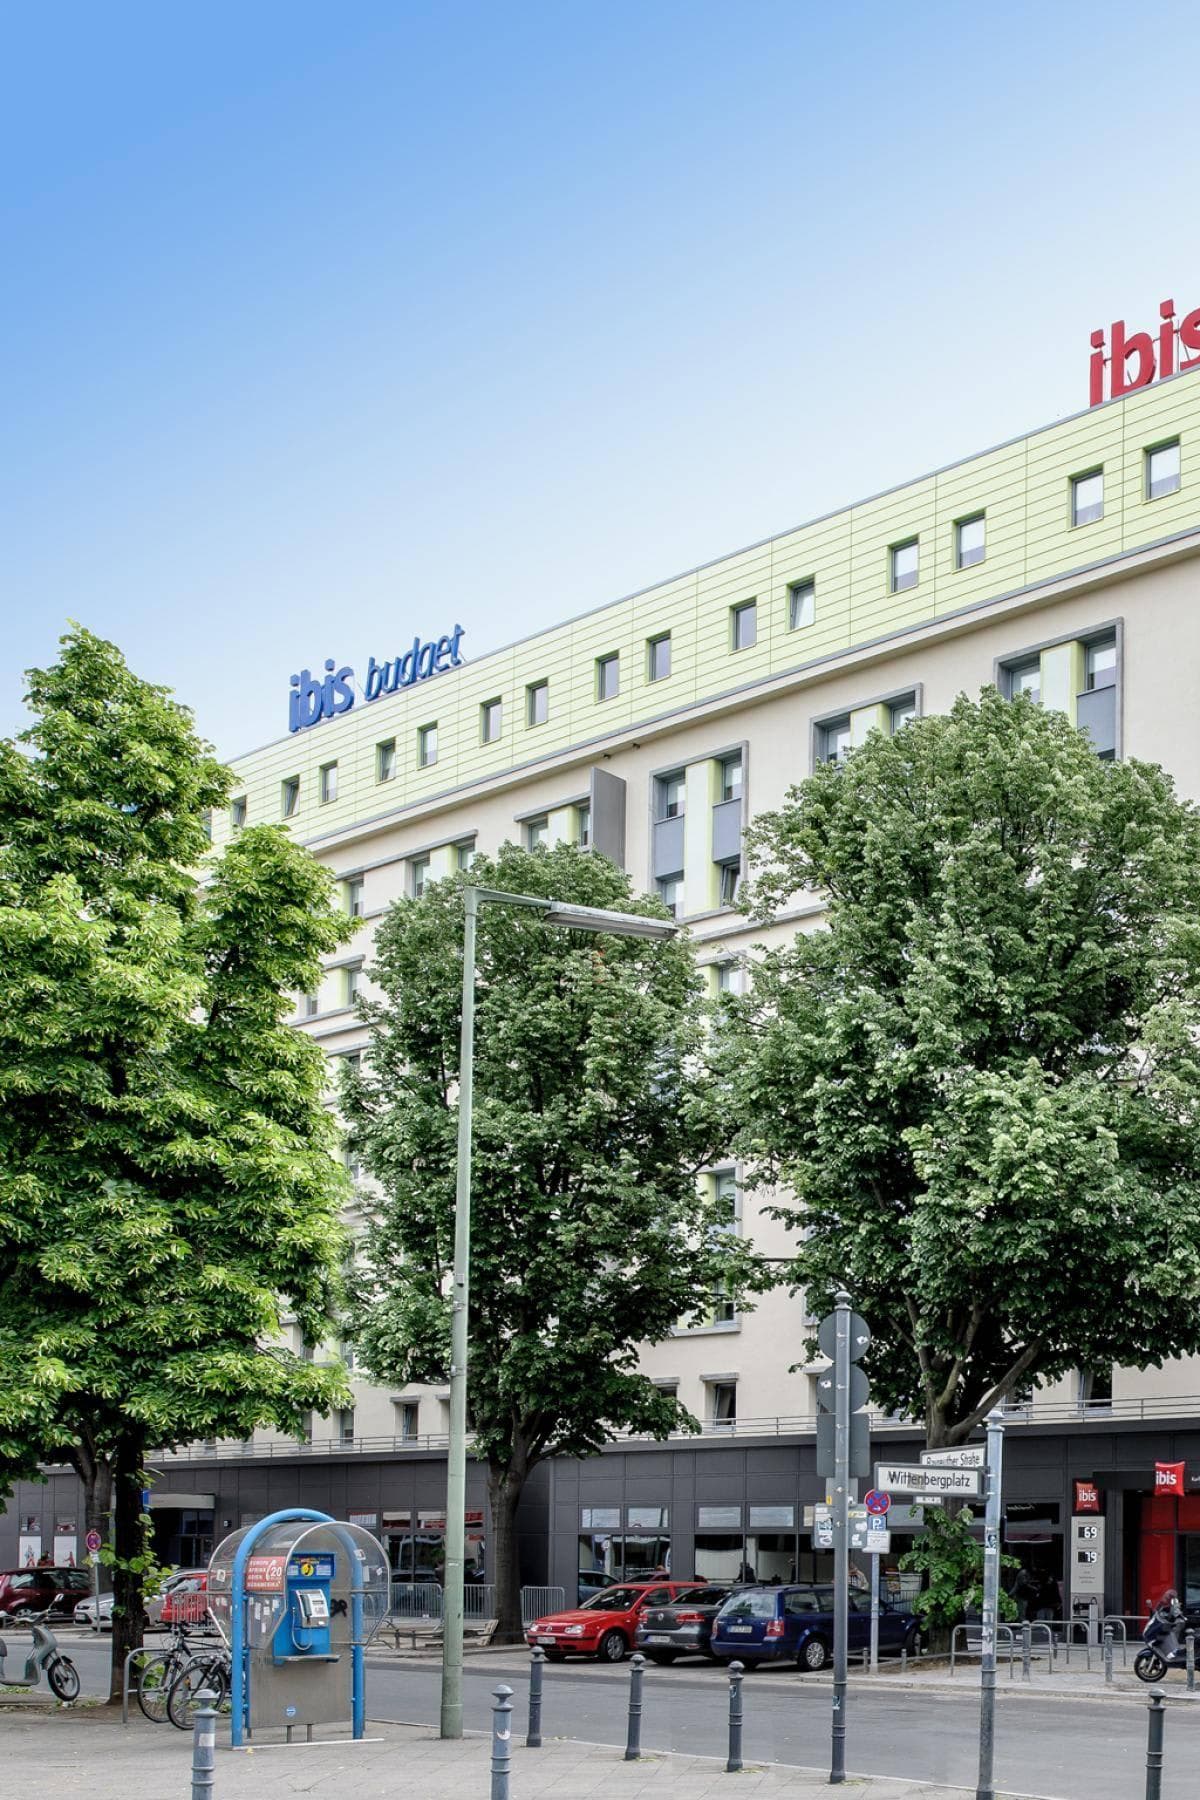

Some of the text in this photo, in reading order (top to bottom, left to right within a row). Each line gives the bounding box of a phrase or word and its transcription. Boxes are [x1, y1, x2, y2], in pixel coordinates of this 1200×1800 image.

[289, 623, 465, 733] ibis budget
[888, 1471, 970, 1489] Wittenbergplatz
[1155, 1471, 1177, 1486] ibis
[1079, 1490, 1097, 1502] ibis
[1083, 1526, 1097, 1538] 69
[270, 1566, 282, 1577] 20
